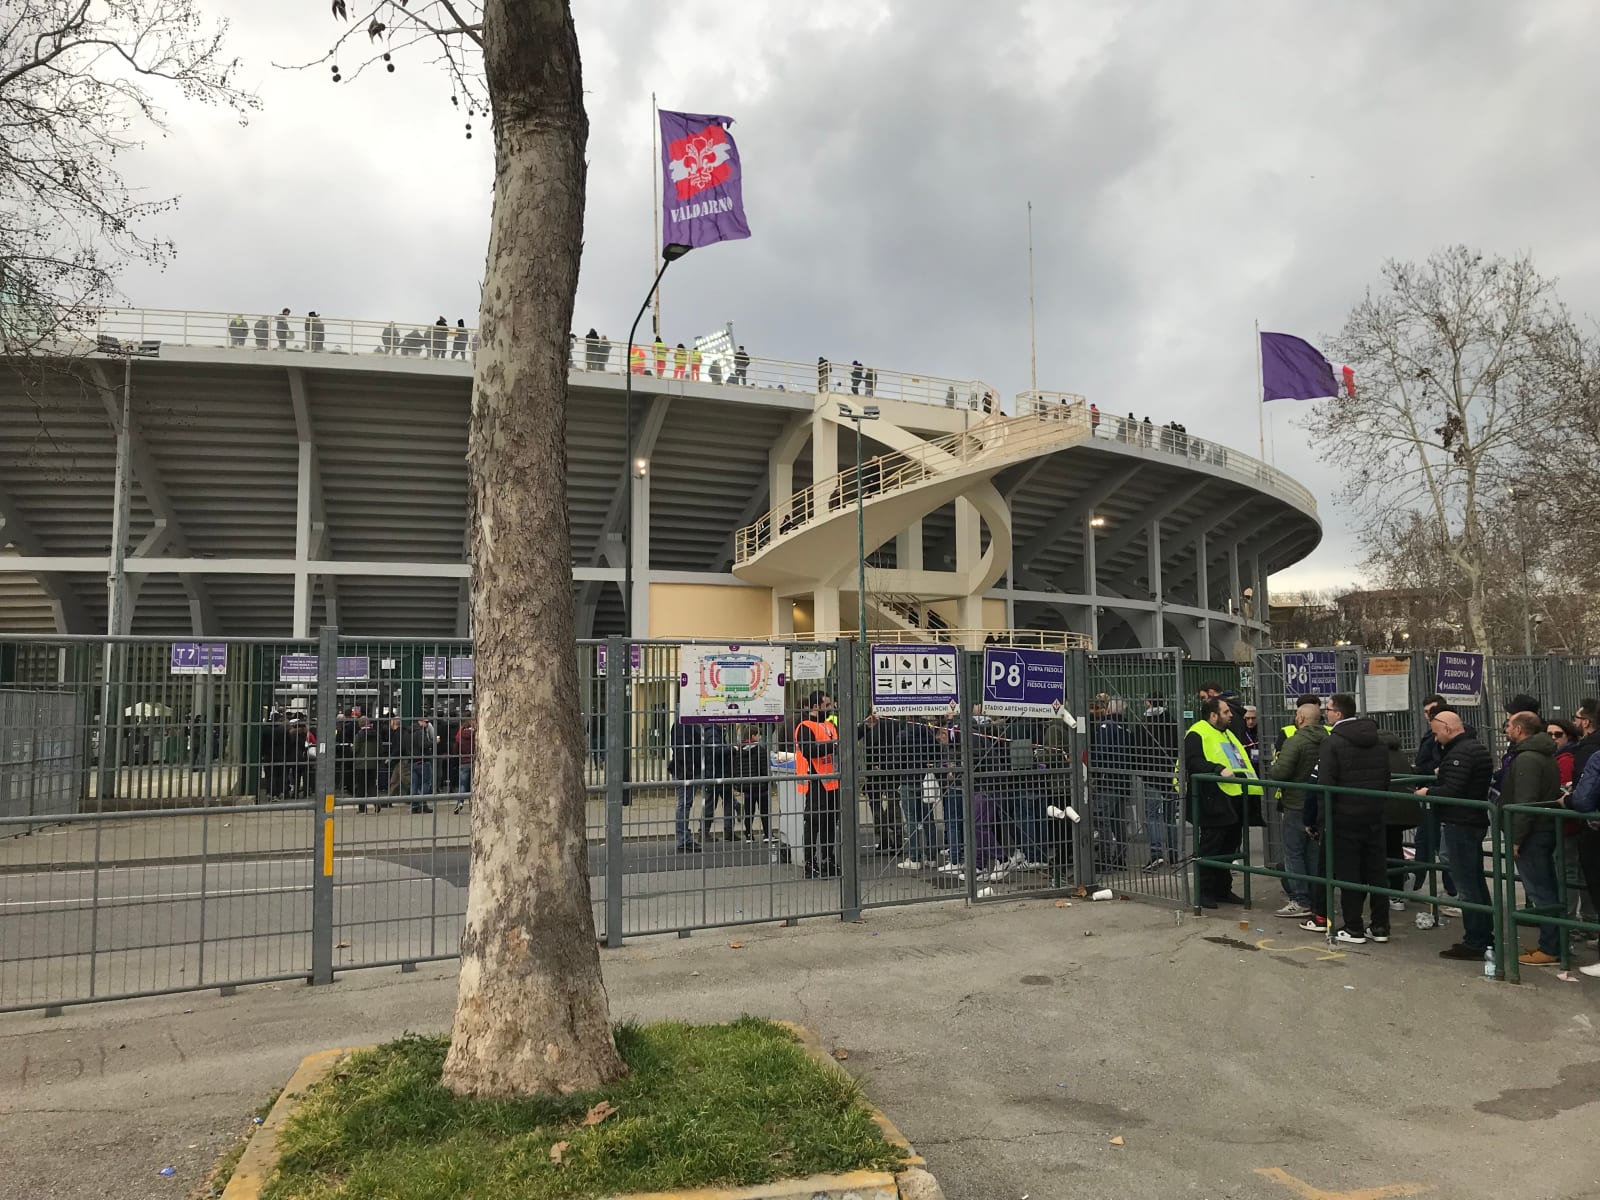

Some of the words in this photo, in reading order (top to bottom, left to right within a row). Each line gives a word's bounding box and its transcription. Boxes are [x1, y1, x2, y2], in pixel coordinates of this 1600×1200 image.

[670, 196, 733, 223] VALDARNO
[1445, 656, 1467, 665] TRIBUNA
[990, 661, 1021, 687] P8
[1027, 665, 1043, 673] CURVA
[1043, 666, 1063, 674] FIESOLE
[1287, 663, 1308, 685] P8
[1444, 669, 1469, 678] FERROVIA
[1026, 681, 1046, 689] FIESOLE
[1047, 682, 1063, 690] CURVE
[1443, 682, 1471, 690] MARATONA
